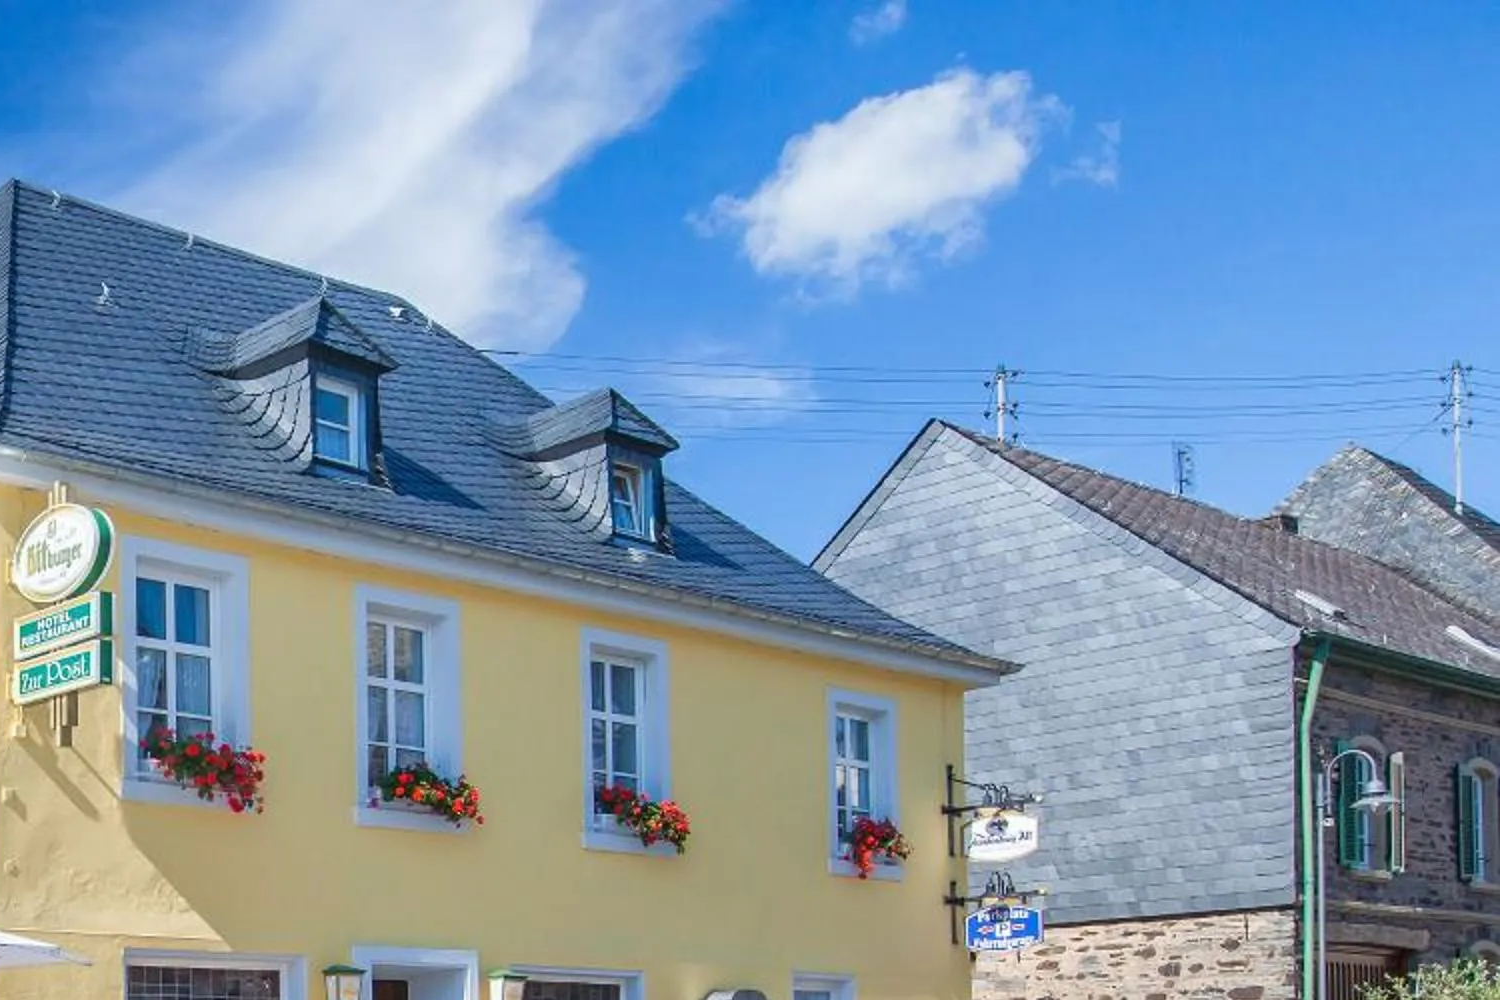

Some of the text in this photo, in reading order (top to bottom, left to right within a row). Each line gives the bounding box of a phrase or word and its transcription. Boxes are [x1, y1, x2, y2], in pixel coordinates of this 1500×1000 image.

[21, 616, 91, 647] RESTAURANT
[36, 609, 70, 630] HOTEL
[21, 653, 88, 693] Zur Post
